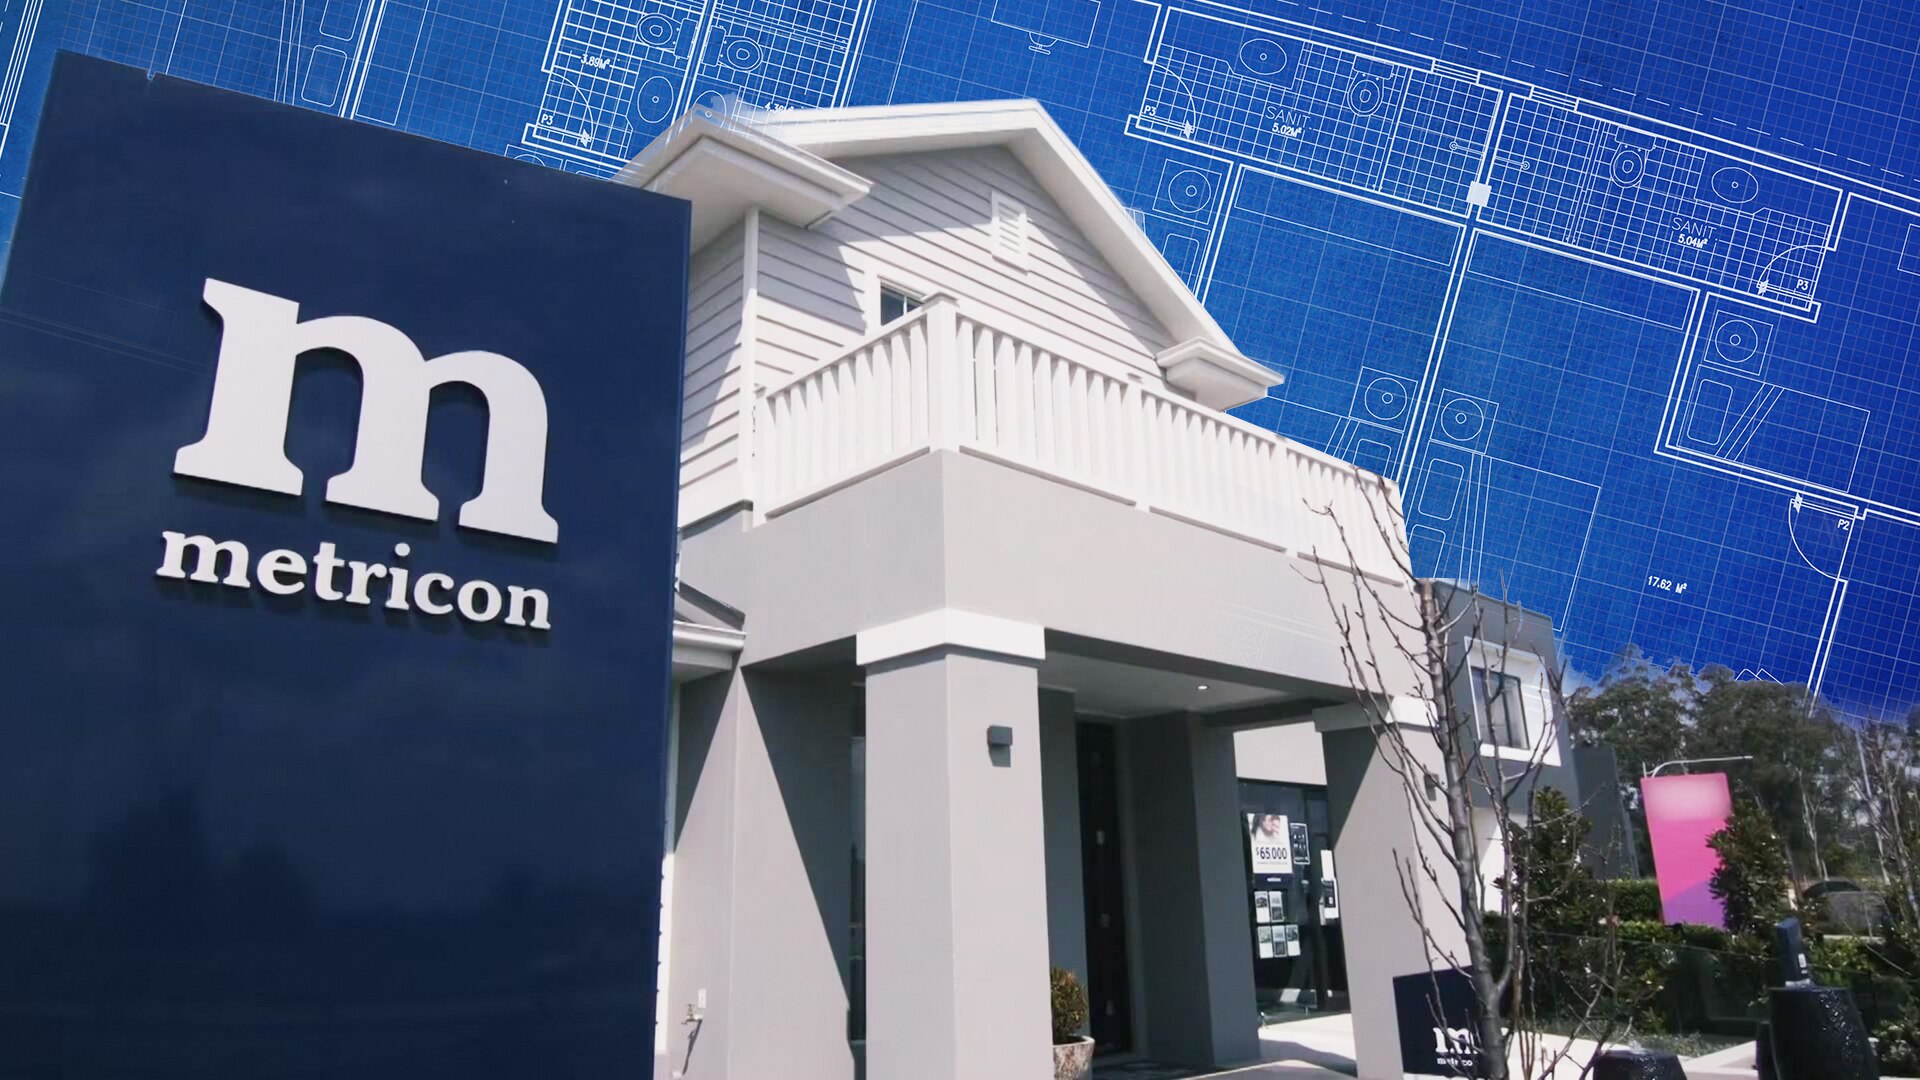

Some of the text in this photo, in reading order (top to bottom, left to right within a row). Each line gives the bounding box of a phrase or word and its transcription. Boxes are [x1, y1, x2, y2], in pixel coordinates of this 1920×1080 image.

[1143, 104, 1157, 117] P3
[540, 113, 554, 125] P3
[1796, 278, 1810, 291] P3
[173, 277, 559, 543] m
[1837, 518, 1850, 531] P2
[156, 530, 551, 630] metricon
[1647, 574, 1673, 591] 17.62
